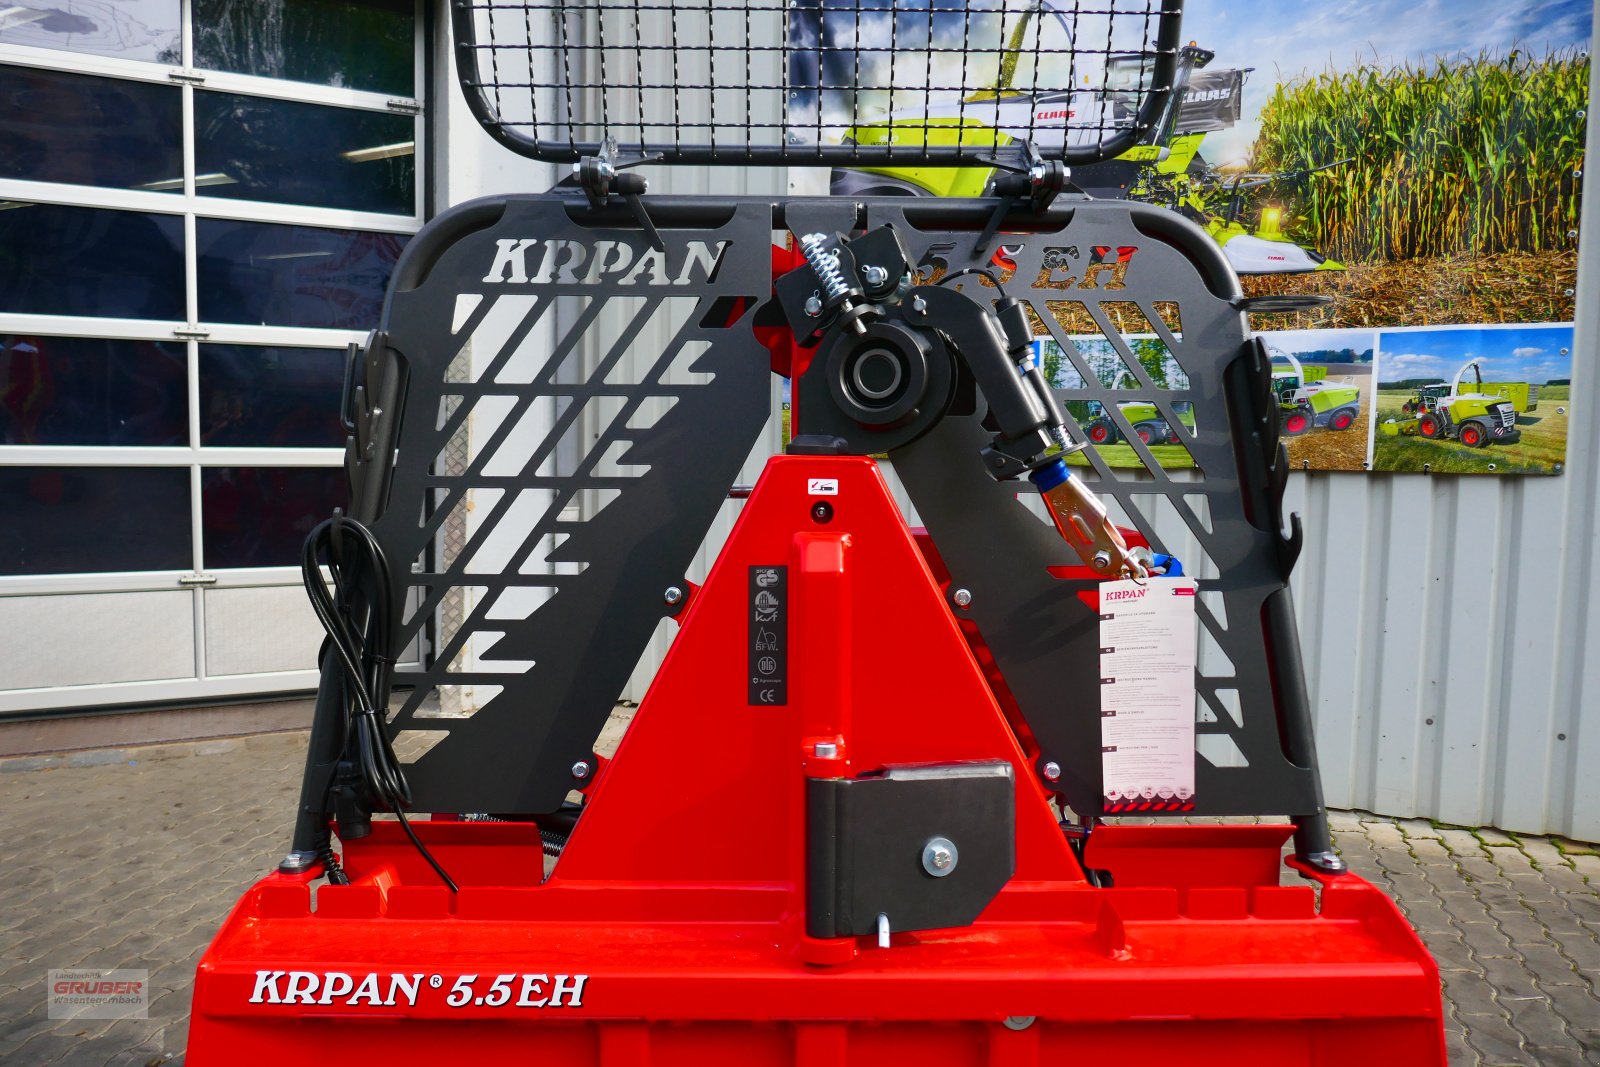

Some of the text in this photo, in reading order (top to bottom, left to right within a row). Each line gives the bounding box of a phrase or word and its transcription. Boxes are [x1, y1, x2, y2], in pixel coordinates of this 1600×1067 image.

[1037, 110, 1075, 119] CLAAS
[482, 239, 733, 286] KRPAN
[1105, 589, 1146, 600] KRPAN
[446, 973, 591, 1008] 5.5EH
